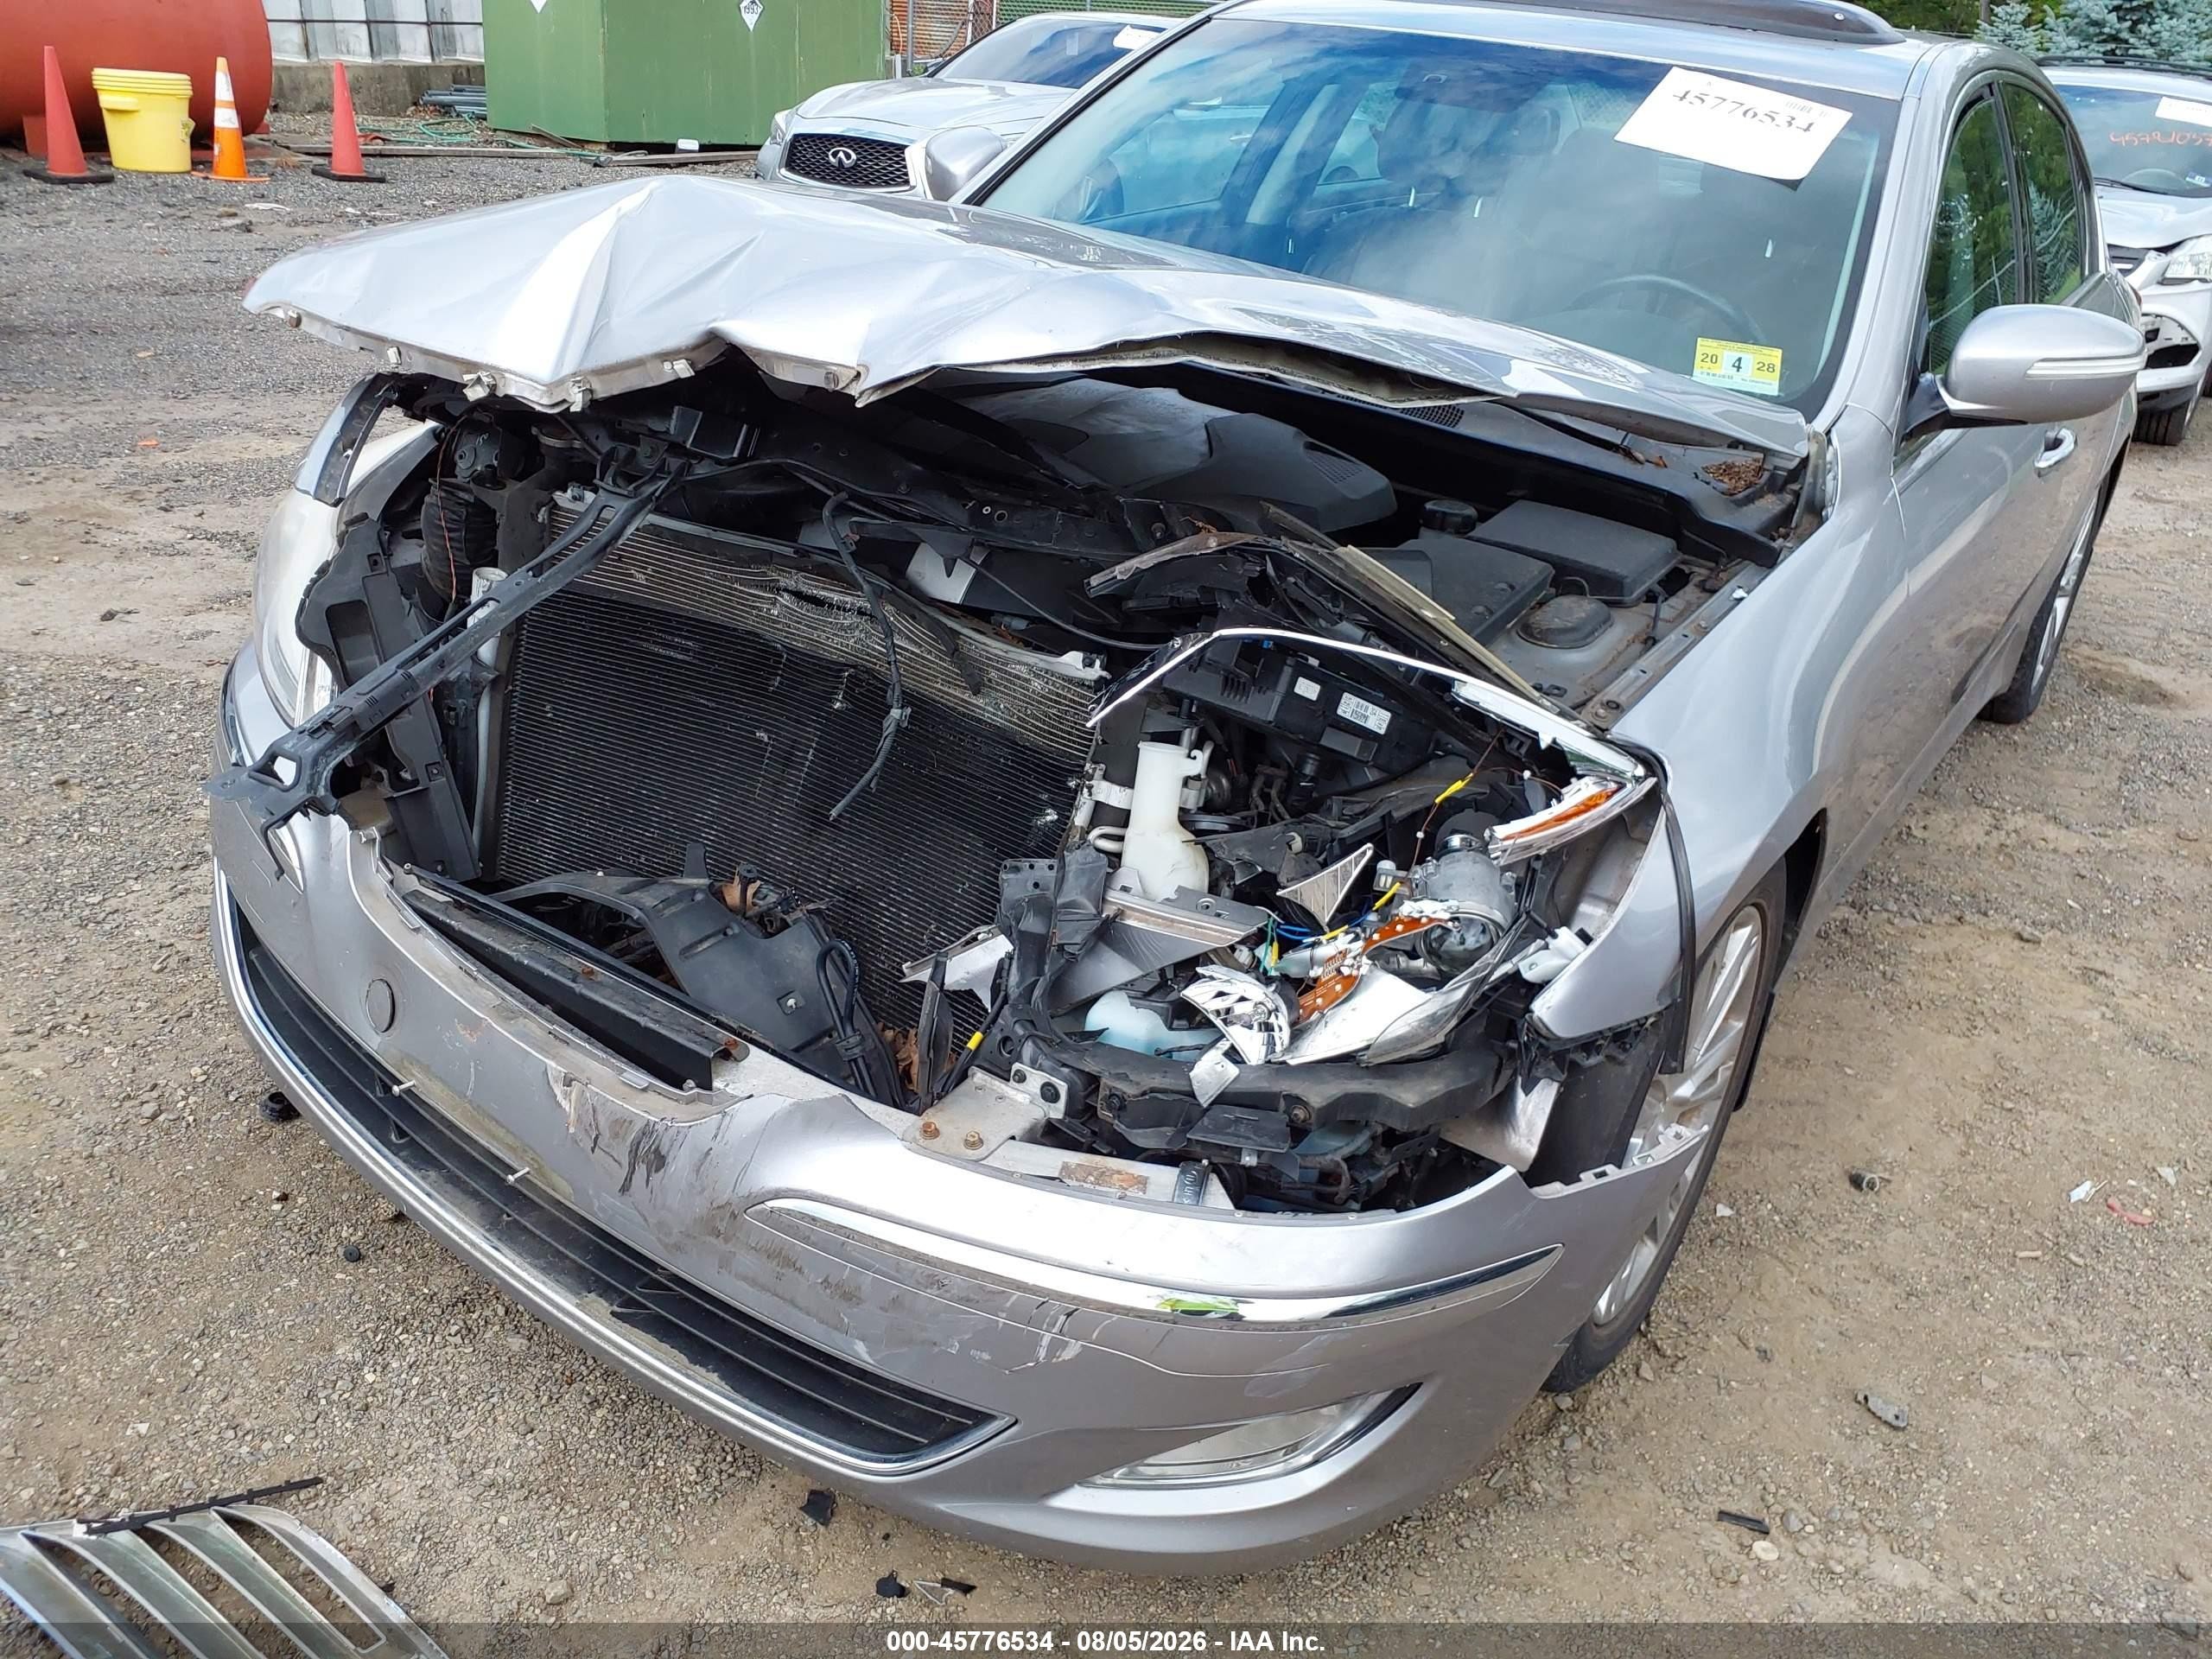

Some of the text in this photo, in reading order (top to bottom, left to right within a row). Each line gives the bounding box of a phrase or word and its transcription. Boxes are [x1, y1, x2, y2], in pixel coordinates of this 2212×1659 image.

[743, 4, 759, 15] 1993
[1672, 89, 1815, 133] 45776534
[1700, 352, 1776, 373] 20 4 28
